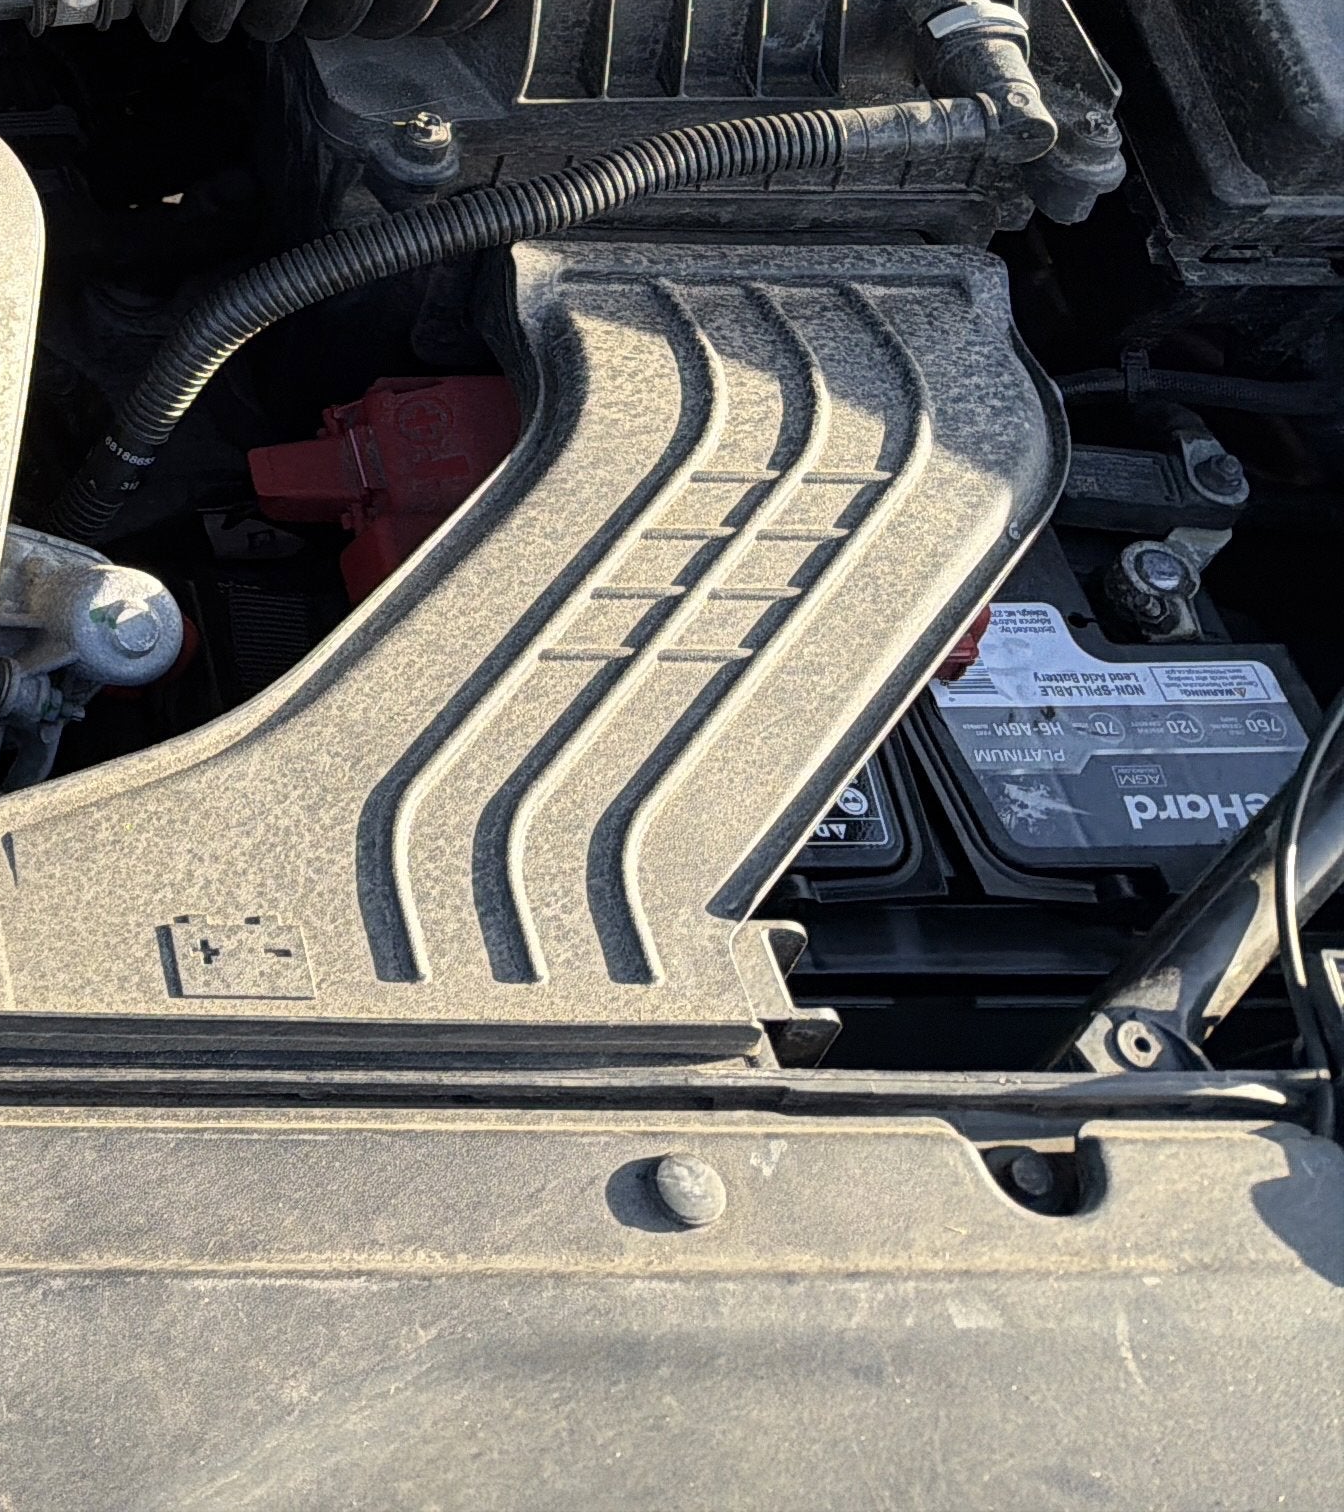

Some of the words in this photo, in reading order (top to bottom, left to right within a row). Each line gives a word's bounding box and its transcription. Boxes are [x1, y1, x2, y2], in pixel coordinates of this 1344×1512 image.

[1033, 671, 1079, 684] Battery
[1079, 672, 1106, 684] Acid
[1108, 672, 1138, 684] Lead
[1038, 684, 1146, 697] NON-SPILLABLE
[992, 721, 1065, 737] H6-AGM
[1094, 721, 1120, 735] 70
[1165, 720, 1199, 734] 120
[1245, 718, 1282, 733] 760
[973, 748, 1066, 762] PLATINUM
[1118, 774, 1160, 785] AGM
